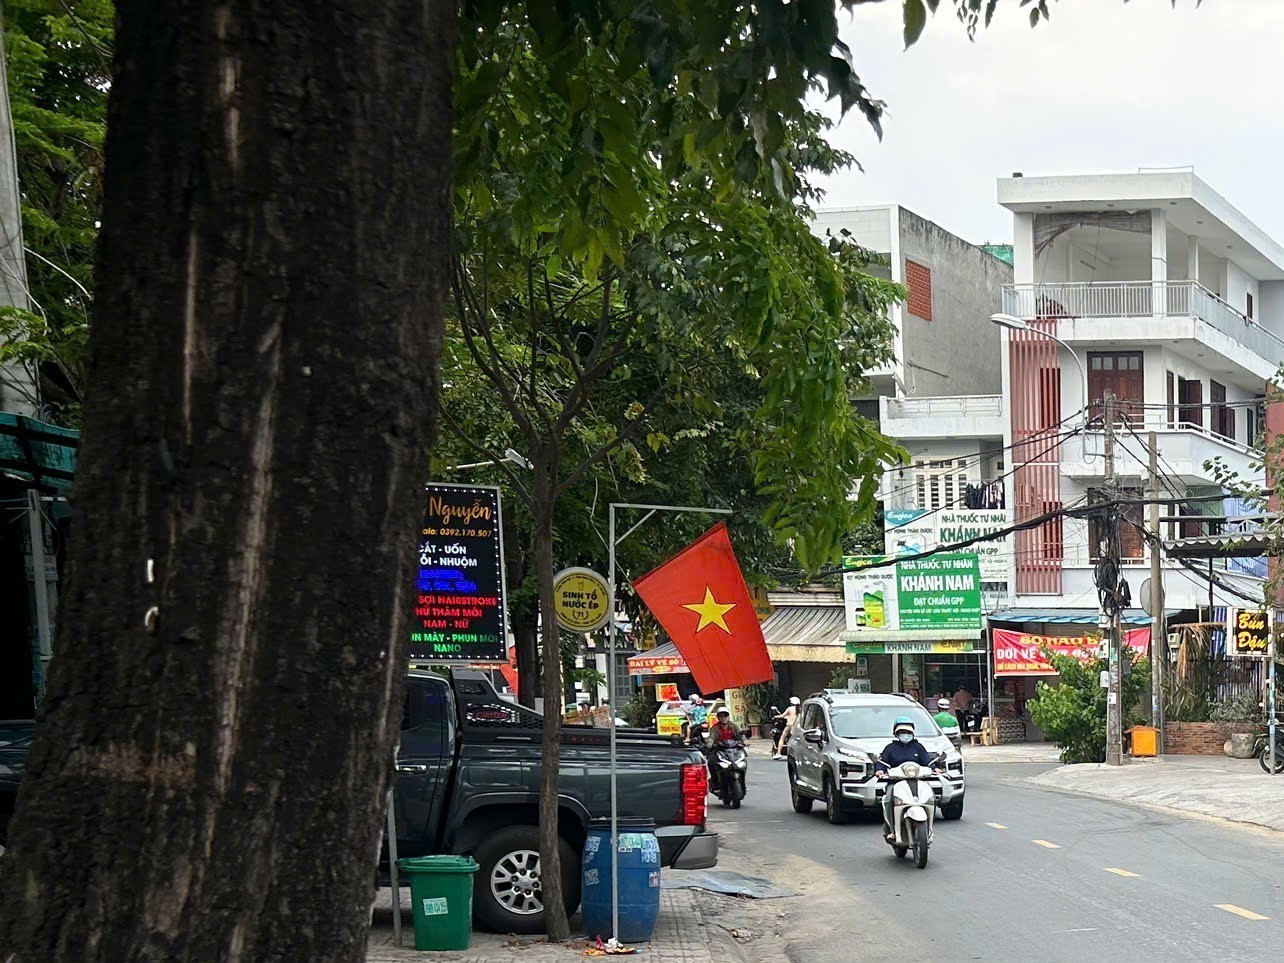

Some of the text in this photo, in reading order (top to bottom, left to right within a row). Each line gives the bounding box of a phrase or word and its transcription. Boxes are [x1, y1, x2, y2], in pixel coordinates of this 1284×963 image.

[429, 496, 491, 525] Nguyễn
[422, 528, 438, 536] alo:
[444, 542, 466, 554] UỐN
[439, 556, 477, 568] NHUỘM
[917, 558, 940, 569] THUỐC
[902, 571, 943, 591] KHÁNH
[946, 575, 975, 591] NAM
[562, 591, 583, 599] SINH
[562, 599, 599, 609] NƯỚC ÉP
[423, 620, 446, 628] NAM
[452, 633, 477, 642] PHUN
[434, 643, 461, 652] NANO
